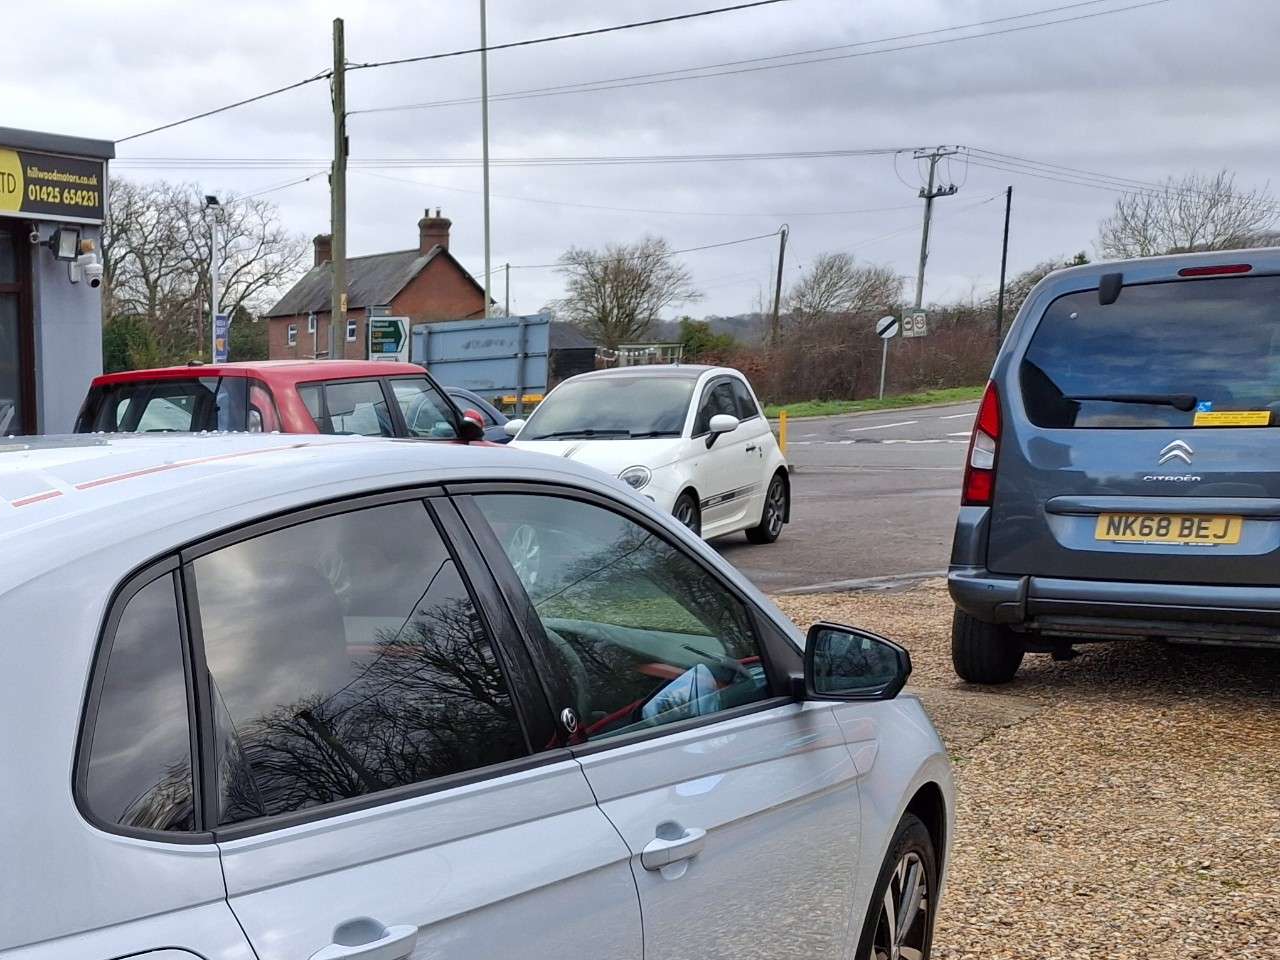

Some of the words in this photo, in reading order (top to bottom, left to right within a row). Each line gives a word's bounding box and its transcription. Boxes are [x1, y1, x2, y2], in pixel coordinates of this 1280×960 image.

[27, 165, 98, 186] hillwoodmotors.co.uk
[28, 184, 61, 204] 01425
[63, 188, 99, 207] 654231
[1106, 515, 1171, 537] NK68
[1178, 516, 1231, 539] BEJ
